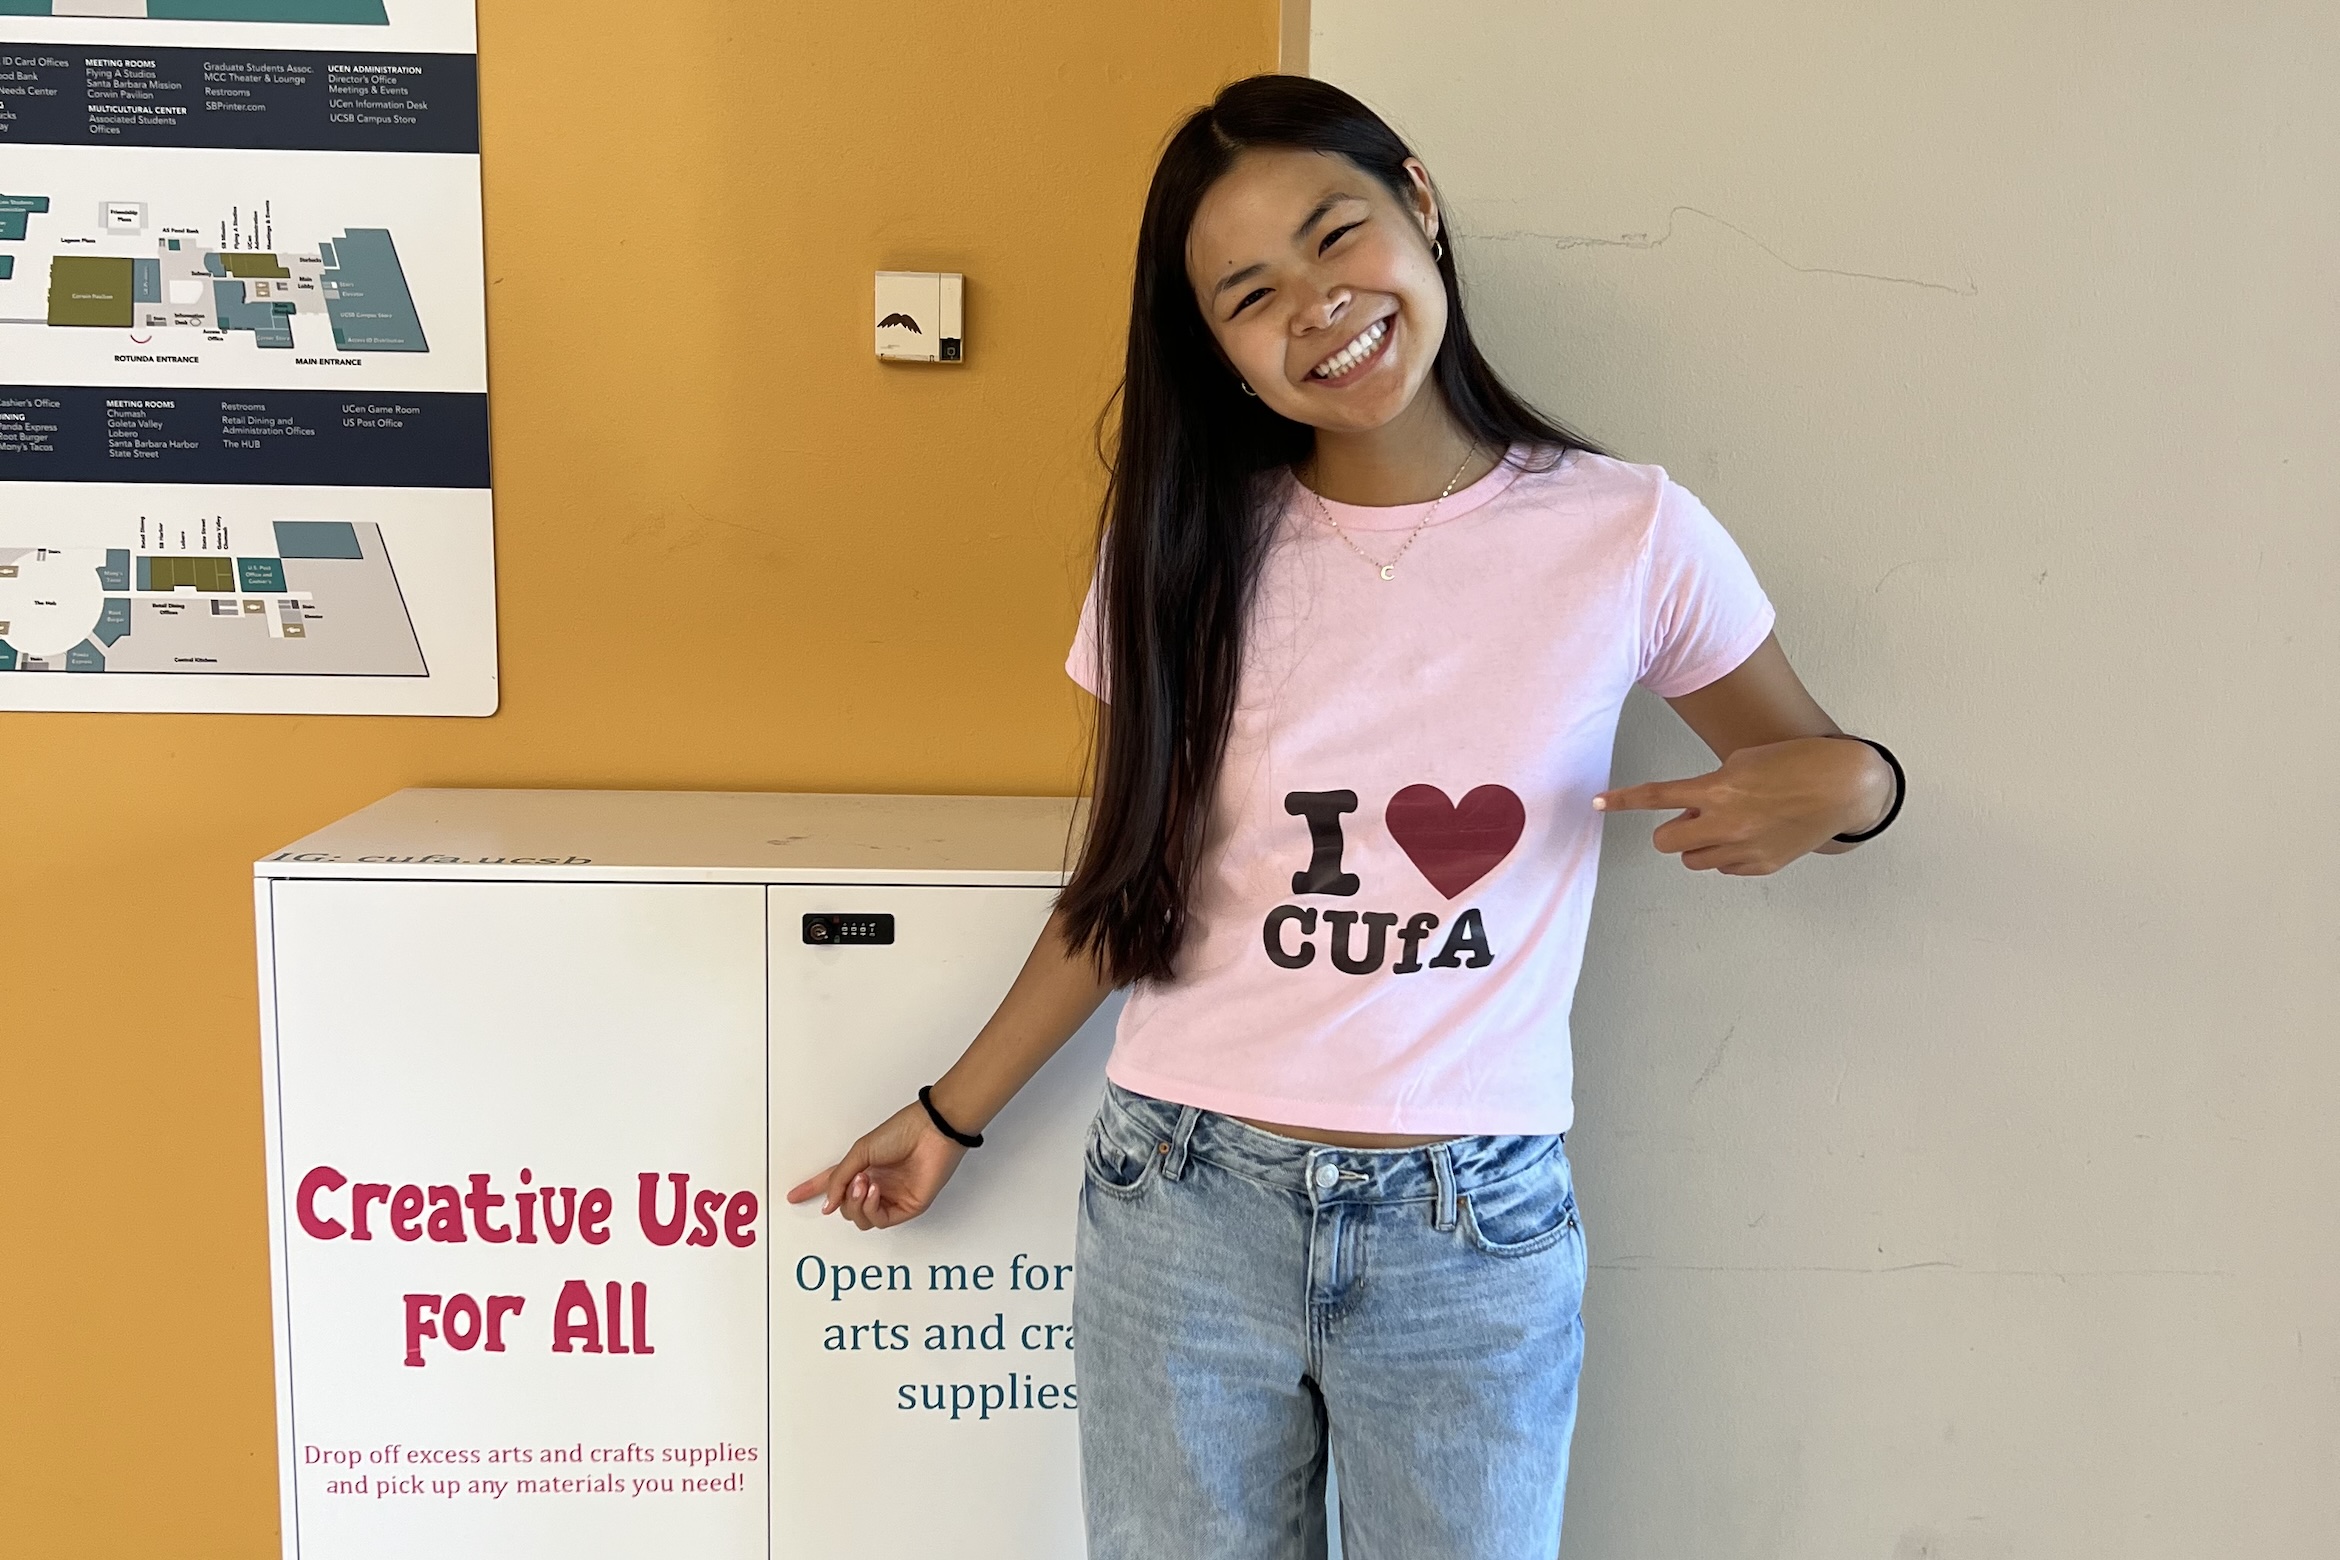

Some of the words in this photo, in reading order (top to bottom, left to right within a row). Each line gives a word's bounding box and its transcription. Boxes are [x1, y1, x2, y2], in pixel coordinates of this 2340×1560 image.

[2, 56, 13, 66] ID
[14, 56, 36, 66] Card
[38, 57, 69, 68] Offices
[84, 59, 123, 68] MEETING
[125, 60, 156, 68] ROOMS
[203, 62, 244, 72] Graduate
[246, 63, 285, 73] Students
[286, 64, 314, 73] Assoc.
[327, 65, 351, 73] UCEN
[353, 65, 422, 74] ADMINISTRATION
[0, 71, 15, 80] ood
[17, 71, 38, 80] Bank
[86, 68, 112, 79] Flying
[114, 69, 122, 78] A
[124, 69, 156, 79] Studios
[204, 72, 226, 81] MCC
[229, 72, 262, 82] Theater
[264, 74, 271, 83] &
[273, 74, 306, 86] Lounge
[328, 74, 369, 84] Director's
[371, 75, 397, 84] Office
[87, 79, 111, 88] Santa
[113, 80, 147, 88] Barbara
[149, 81, 182, 90] Mission
[28, 86, 58, 96] Center
[87, 89, 118, 98] Corwin
[120, 90, 154, 99] Pavilion
[204, 86, 251, 97] Restrooms
[328, 85, 369, 96] Meetings
[371, 86, 377, 94] &
[380, 86, 408, 95] Events
[205, 101, 266, 111] SBPrinter.com
[329, 99, 353, 108] UCen
[356, 99, 404, 109] Information
[406, 101, 428, 110] Desk
[88, 105, 153, 114] MULTICULTURAL
[155, 106, 187, 115] CENTER
[89, 114, 136, 124] Associated
[138, 115, 176, 125] Students
[330, 113, 354, 122] UCSB
[357, 114, 391, 125] Campus
[393, 115, 416, 124] Store
[89, 125, 120, 134] Offices
[114, 355, 154, 363] ROTUNDA
[295, 358, 317, 366] MAIN
[319, 358, 362, 366] ENTRANCE
[0, 398, 32, 407] ashier's
[34, 398, 61, 408] Office
[106, 400, 143, 408] MEETING
[144, 400, 175, 409] ROOMS
[221, 402, 266, 411] Restrooms
[107, 409, 147, 418] Chumash
[342, 404, 366, 413] UCen
[368, 405, 393, 414] Game
[395, 405, 420, 414] Room
[107, 419, 136, 428] Goleta
[138, 419, 163, 431] Valley
[221, 415, 246, 425] Retail
[247, 416, 275, 427] Dining
[277, 417, 294, 425] and
[342, 418, 355, 427] US
[357, 418, 375, 427] Post
[377, 418, 403, 428] Office
[25, 422, 58, 432] Express
[222, 426, 284, 435] Administration
[285, 426, 315, 436] Offices
[19, 432, 48, 443] Burger
[108, 429, 138, 438] Lobero
[29, 442, 53, 451] Tacos
[108, 439, 133, 448] Santa
[134, 439, 167, 448] Barbara
[169, 440, 199, 449] Harbor
[223, 440, 239, 448] The
[241, 440, 261, 449] HUB
[109, 449, 131, 458] State
[133, 449, 160, 458] Street
[1284, 789, 1360, 897] I
[272, 852, 341, 862] IG:
[358, 854, 592, 865] cufa.ucsb
[1263, 904, 1495, 975] CUfA
[297, 1166, 612, 1245] Creative
[638, 1172, 759, 1248] Use
[796, 1255, 912, 1301] Open
[928, 1264, 994, 1291] me
[1009, 1253, 1073, 1291] for
[552, 1280, 655, 1355] All
[823, 1319, 910, 1351] arts
[924, 1313, 1006, 1351] and
[898, 1372, 1079, 1420] supplies
[304, 1445, 362, 1469] Drop
[369, 1444, 402, 1465] off
[406, 1448, 481, 1464] excess
[487, 1446, 533, 1464] arts
[539, 1443, 583, 1463] and
[590, 1442, 655, 1463] crafts
[661, 1441, 759, 1466] supplies
[326, 1474, 369, 1496] and
[376, 1474, 425, 1499] pick
[432, 1478, 460, 1498] up
[468, 1478, 509, 1499] any
[516, 1472, 625, 1494] materials
[631, 1476, 674, 1497] you
[681, 1472, 745, 1493] need!
